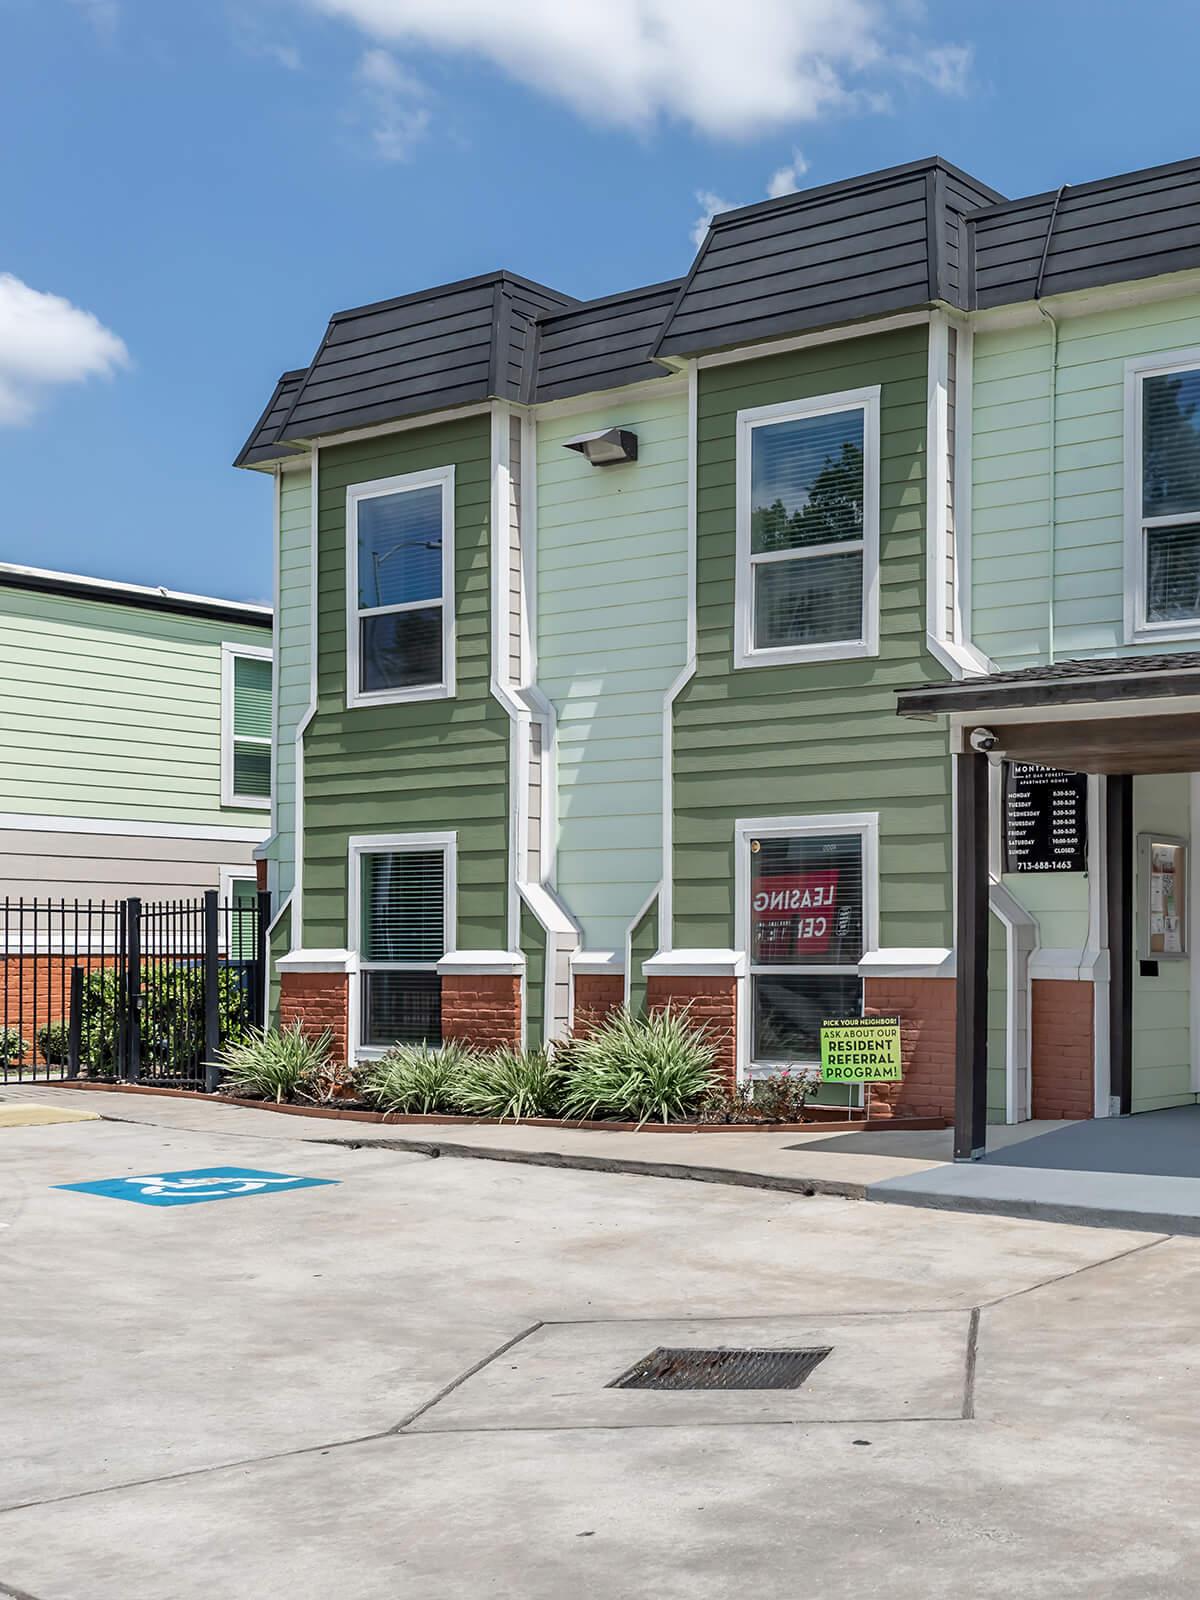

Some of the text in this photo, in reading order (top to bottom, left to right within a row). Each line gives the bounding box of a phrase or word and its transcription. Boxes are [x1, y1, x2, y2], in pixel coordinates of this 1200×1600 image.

[840, 1018, 859, 1026] YOUR
[824, 1029, 897, 1039] ASK ABOUT OUR
[829, 1040, 893, 1051] RESIDENT
[828, 1053, 895, 1065] REFERRAL
[826, 1066, 897, 1078] PROGRAM!
